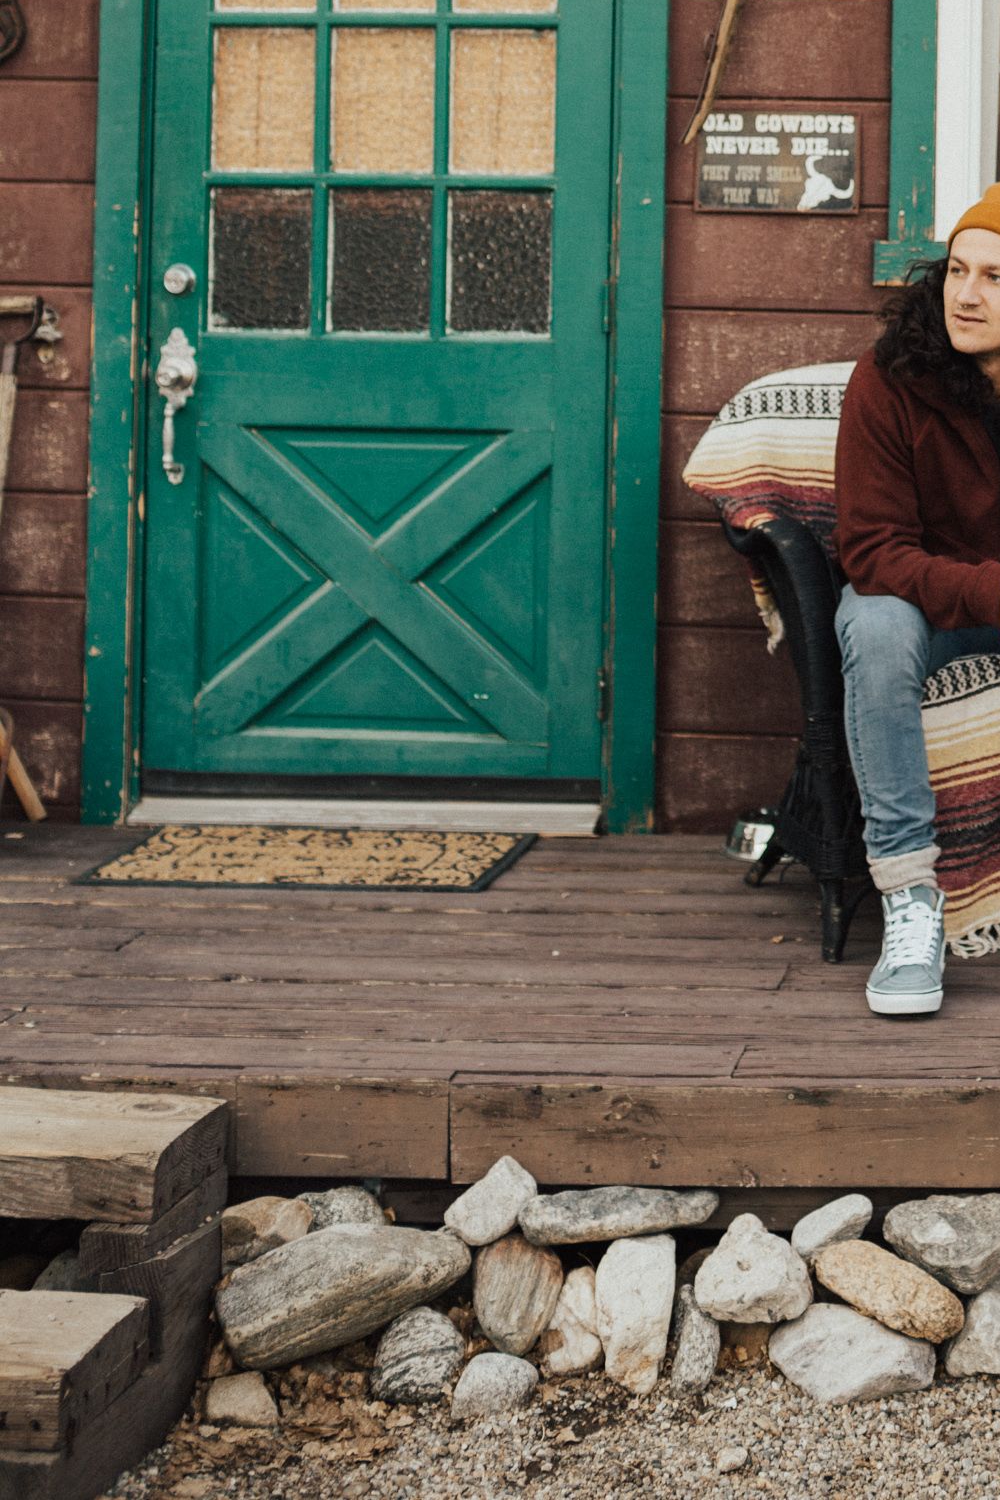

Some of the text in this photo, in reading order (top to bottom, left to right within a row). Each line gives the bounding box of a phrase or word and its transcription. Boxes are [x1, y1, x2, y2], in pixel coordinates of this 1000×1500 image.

[703, 113, 855, 134] OLD COWBOYS
[706, 136, 850, 156] NEVER DIE...
[702, 165, 803, 182] THEY JUST SMELL
[722, 187, 780, 204] THAT WAY
